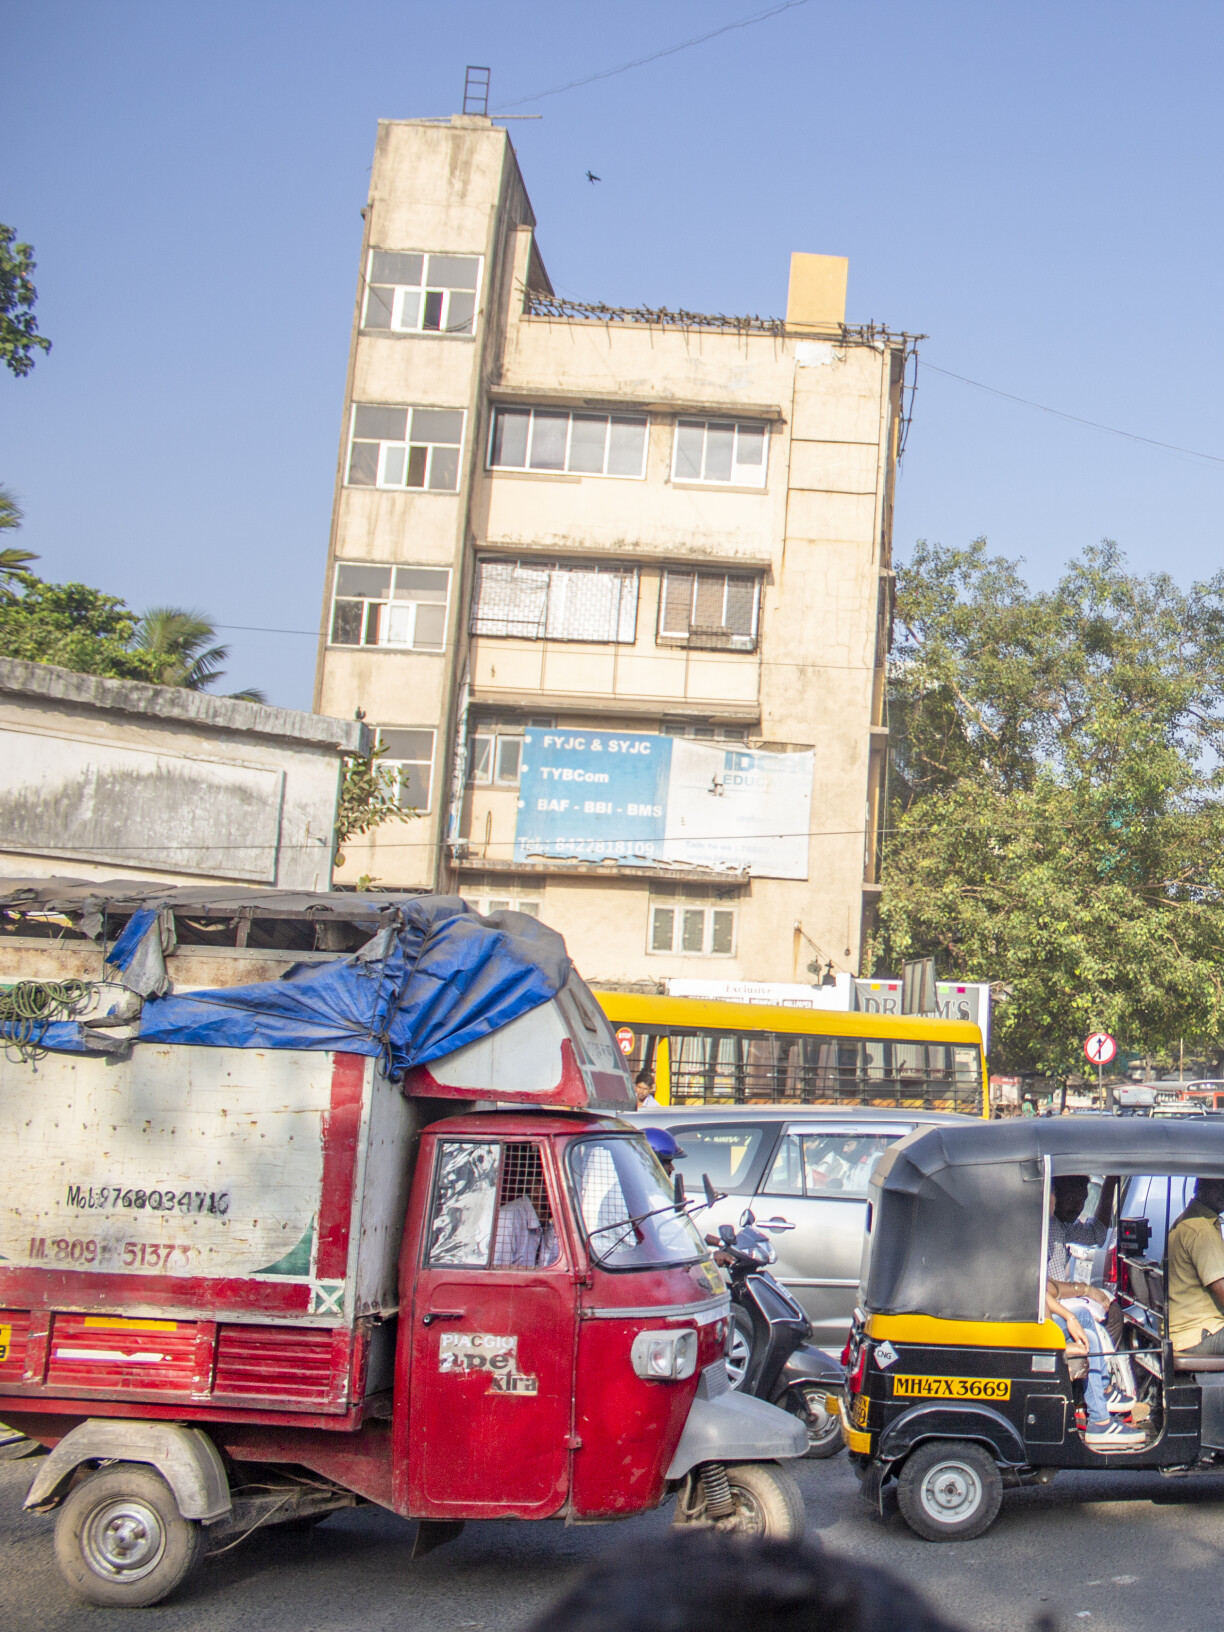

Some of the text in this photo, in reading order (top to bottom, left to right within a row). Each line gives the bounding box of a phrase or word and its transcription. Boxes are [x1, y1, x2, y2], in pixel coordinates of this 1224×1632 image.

[543, 735, 652, 755] FYJC & SYJC
[540, 767, 609, 783] TYBCom
[537, 800, 570, 812] BAF
[584, 802, 612, 814] BBI
[627, 804, 663, 818] BMS
[555, 837, 655, 855] 8422818109
[725, 984, 773, 995] Exclusive
[876, 1350, 892, 1360] CNG
[490, 1371, 537, 1392] xtra
